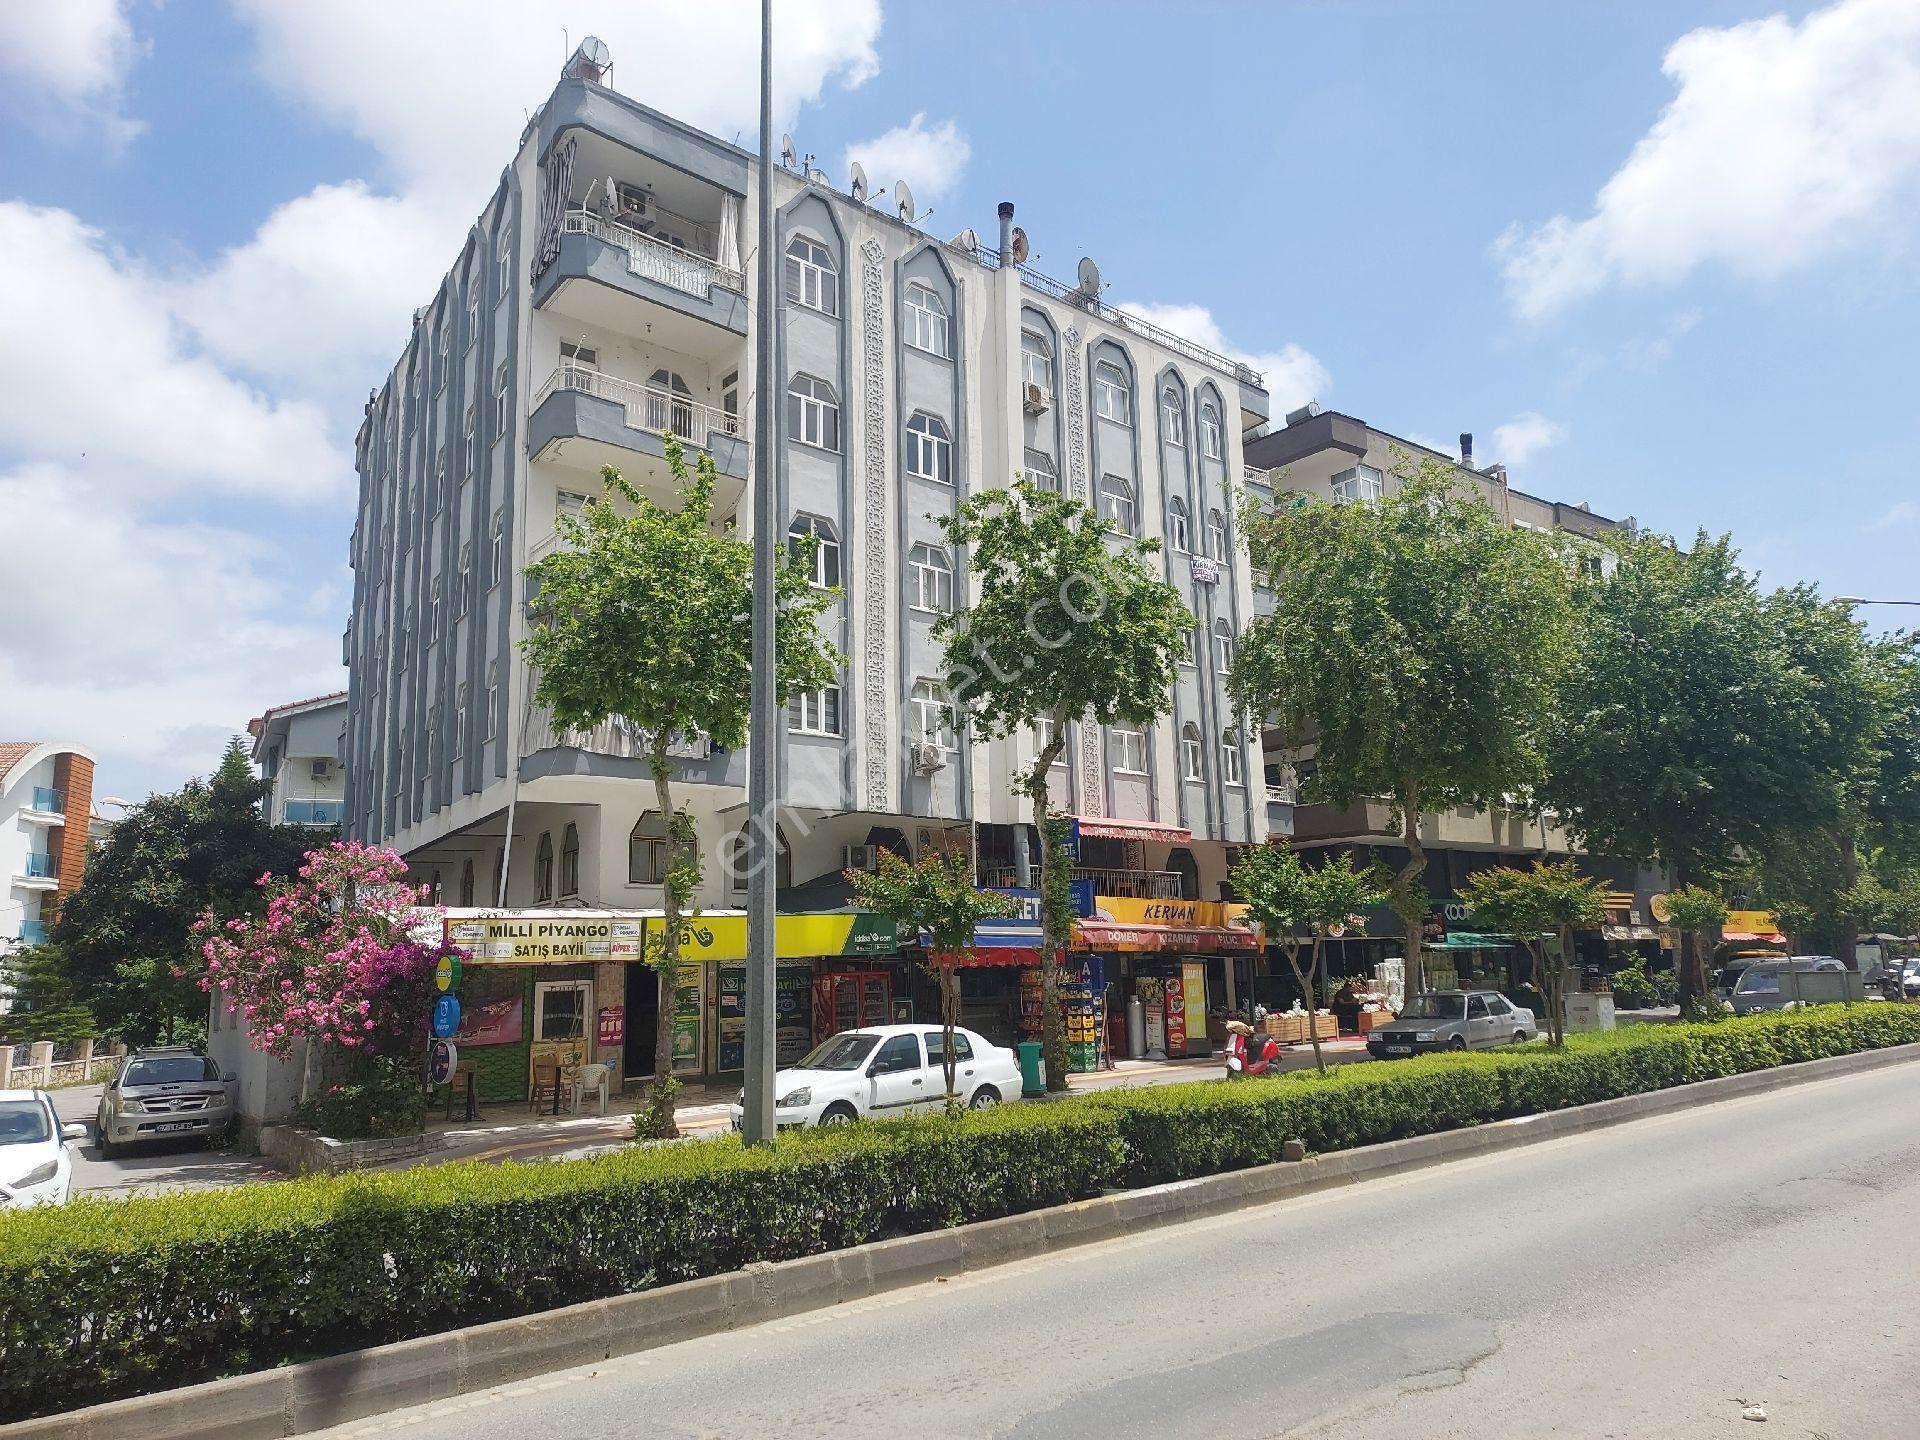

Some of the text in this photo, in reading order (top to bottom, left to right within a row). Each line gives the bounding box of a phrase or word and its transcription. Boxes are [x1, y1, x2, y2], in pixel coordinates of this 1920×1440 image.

[1144, 904, 1196, 921] KERVAN
[489, 922, 609, 938] MİLLİ PİYANGO
[514, 944, 550, 960] SATIŞ
[552, 942, 584, 956] BAYİİ
